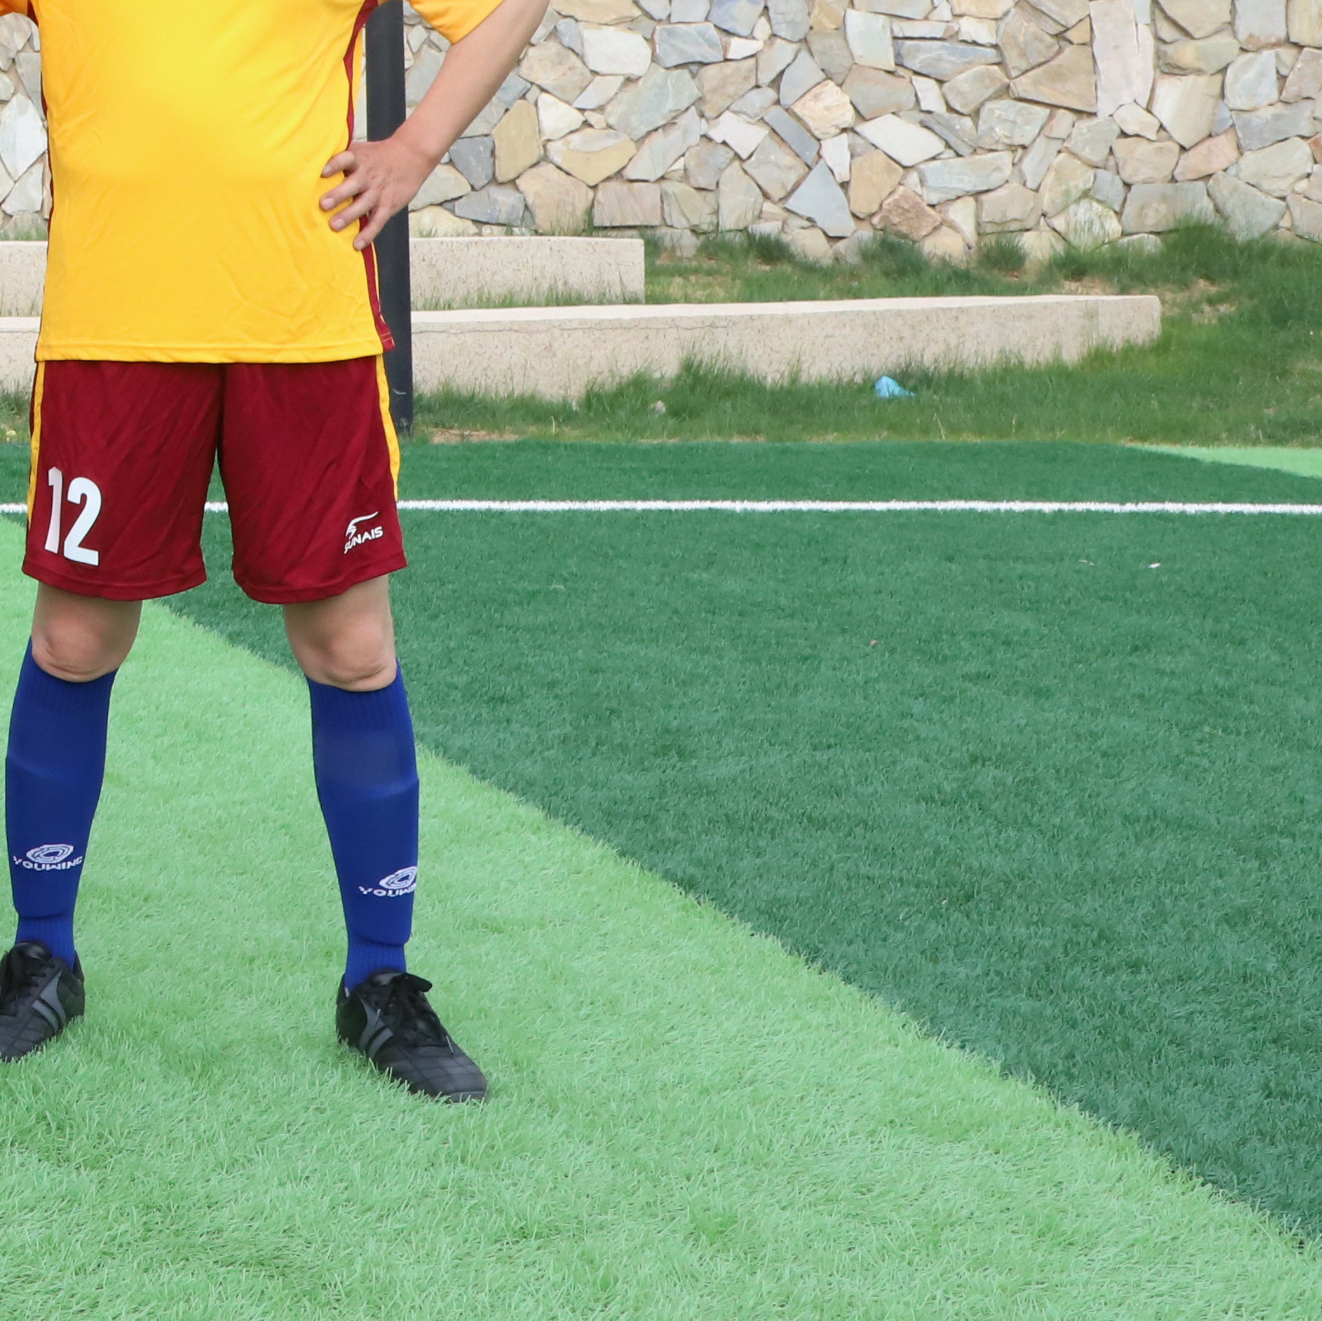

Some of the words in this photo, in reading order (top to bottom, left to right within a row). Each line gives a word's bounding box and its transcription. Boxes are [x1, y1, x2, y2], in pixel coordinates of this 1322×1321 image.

[44, 466, 102, 566] 12
[343, 525, 384, 555] SUNAIS
[13, 855, 83, 871] YOUWING
